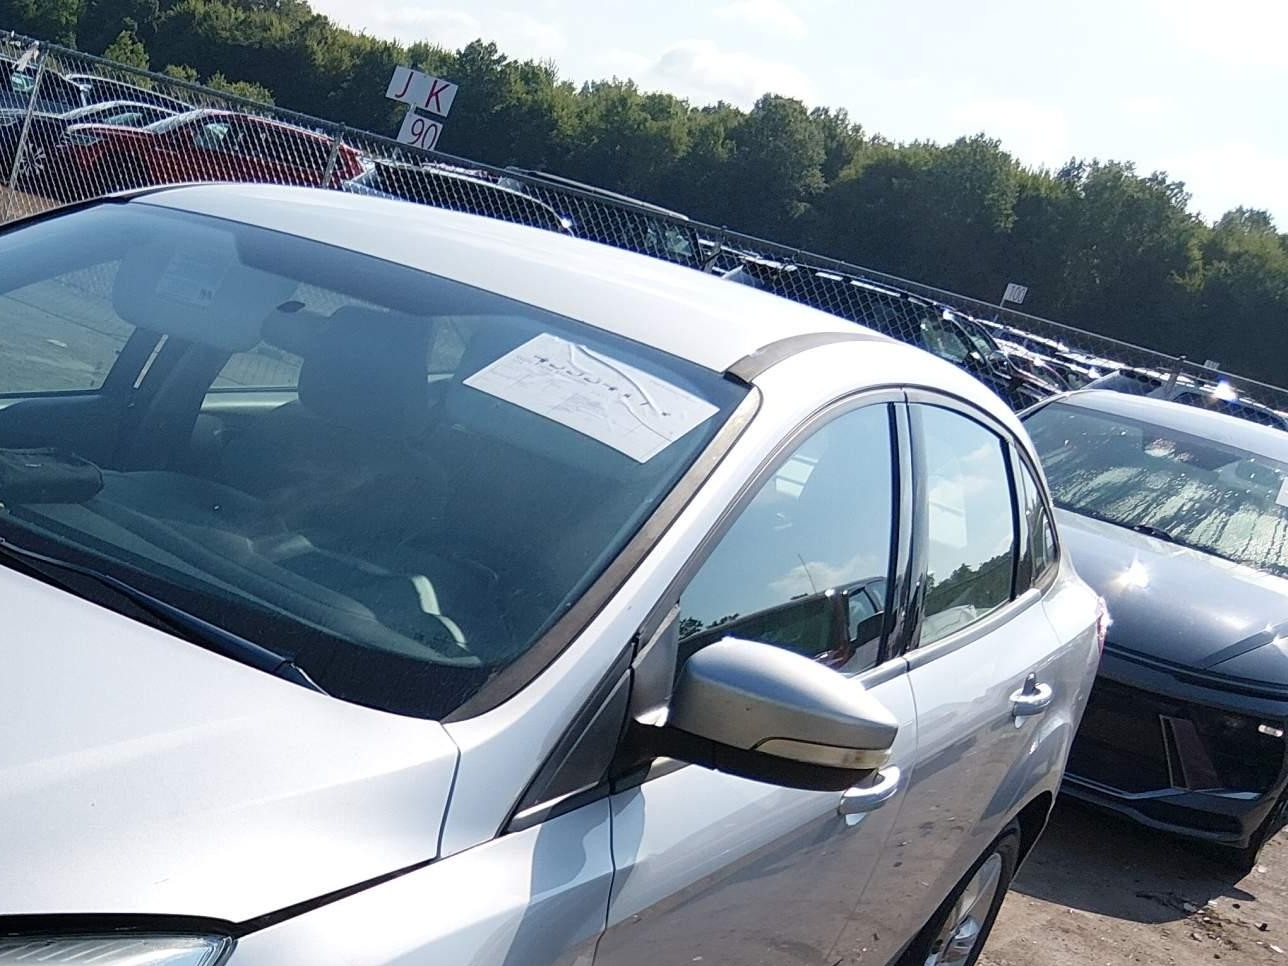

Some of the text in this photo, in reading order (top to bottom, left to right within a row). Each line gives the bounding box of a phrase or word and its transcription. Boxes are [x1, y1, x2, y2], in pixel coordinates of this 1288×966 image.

[394, 71, 450, 113] J K
[407, 118, 438, 150] 90
